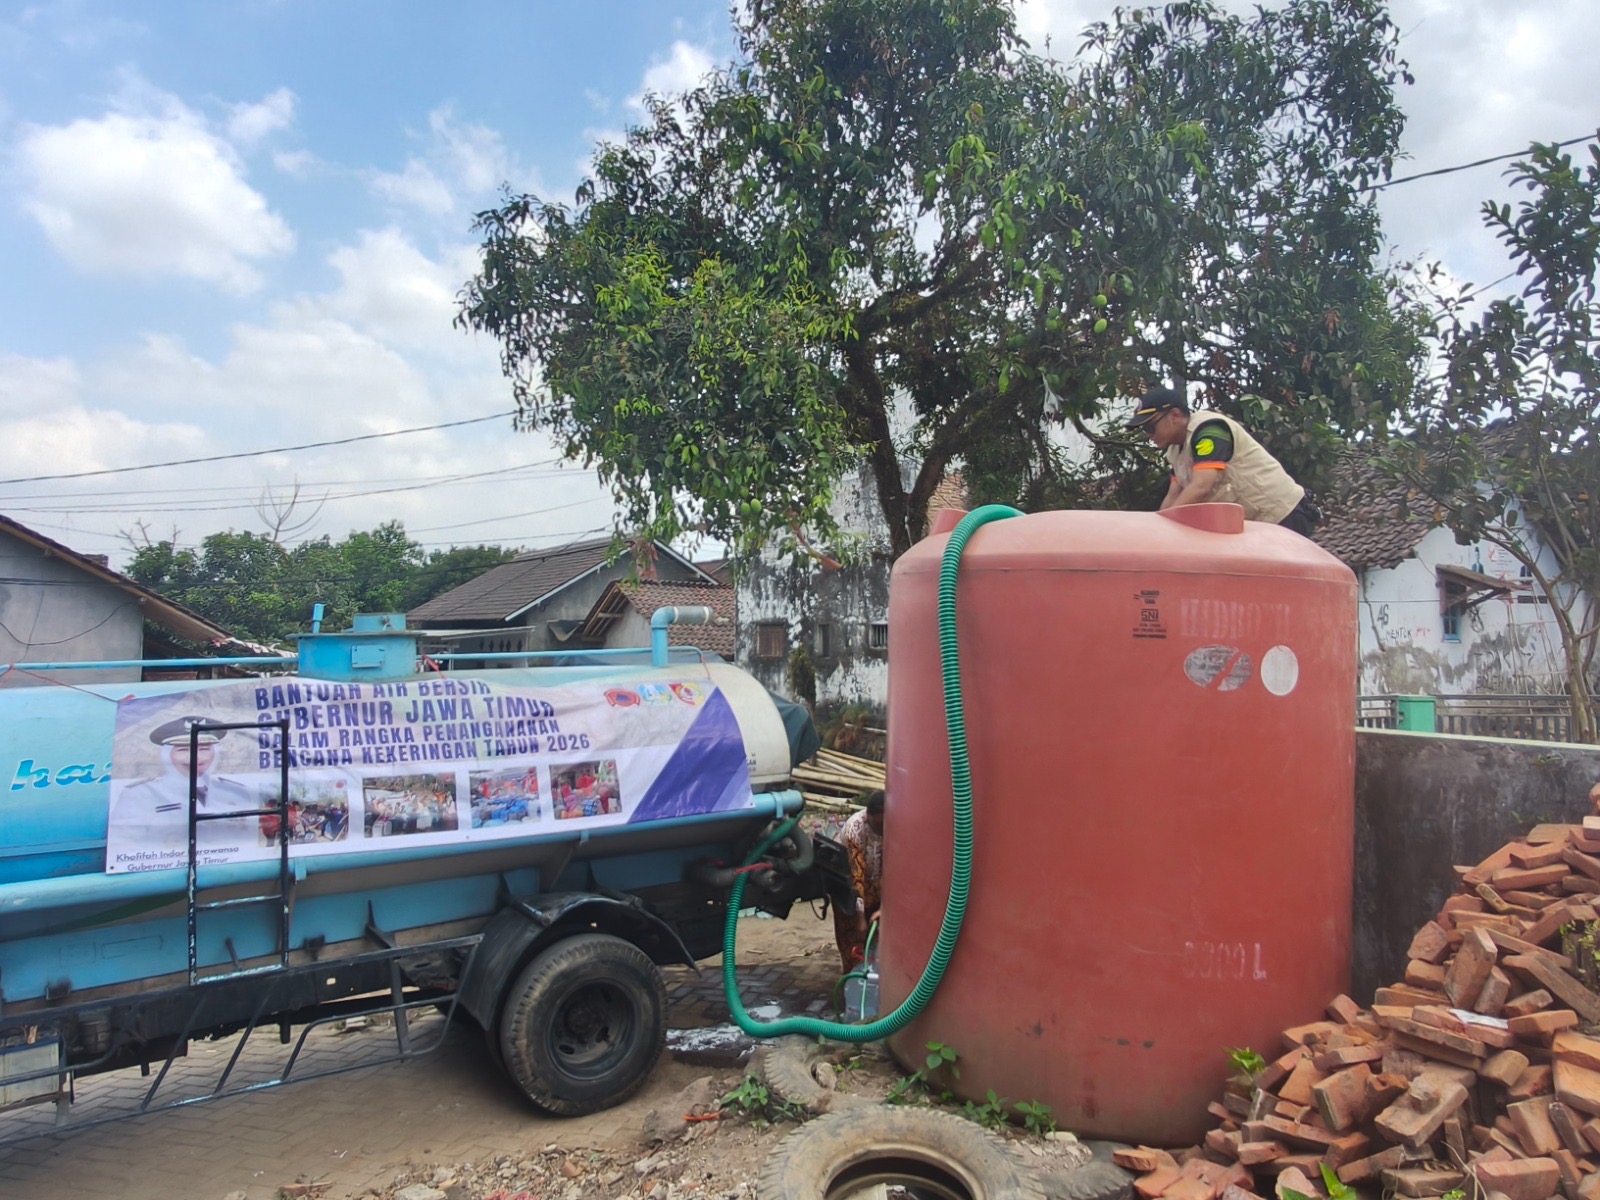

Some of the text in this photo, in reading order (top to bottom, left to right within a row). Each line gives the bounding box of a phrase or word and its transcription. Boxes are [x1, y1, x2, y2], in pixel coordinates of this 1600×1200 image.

[1141, 609, 1159, 621] SNI
[255, 683, 362, 711] BANTUAN
[373, 682, 408, 699] AIR
[258, 696, 554, 732] GUBERNUR JAWA TIMUR
[258, 731, 329, 749] DALAM
[339, 726, 415, 747] RANGKA
[259, 733, 591, 769] BENCANA KEKERINGAN TAHUN 2026
[127, 861, 174, 872] Gubernur
[203, 856, 230, 865] Timur
